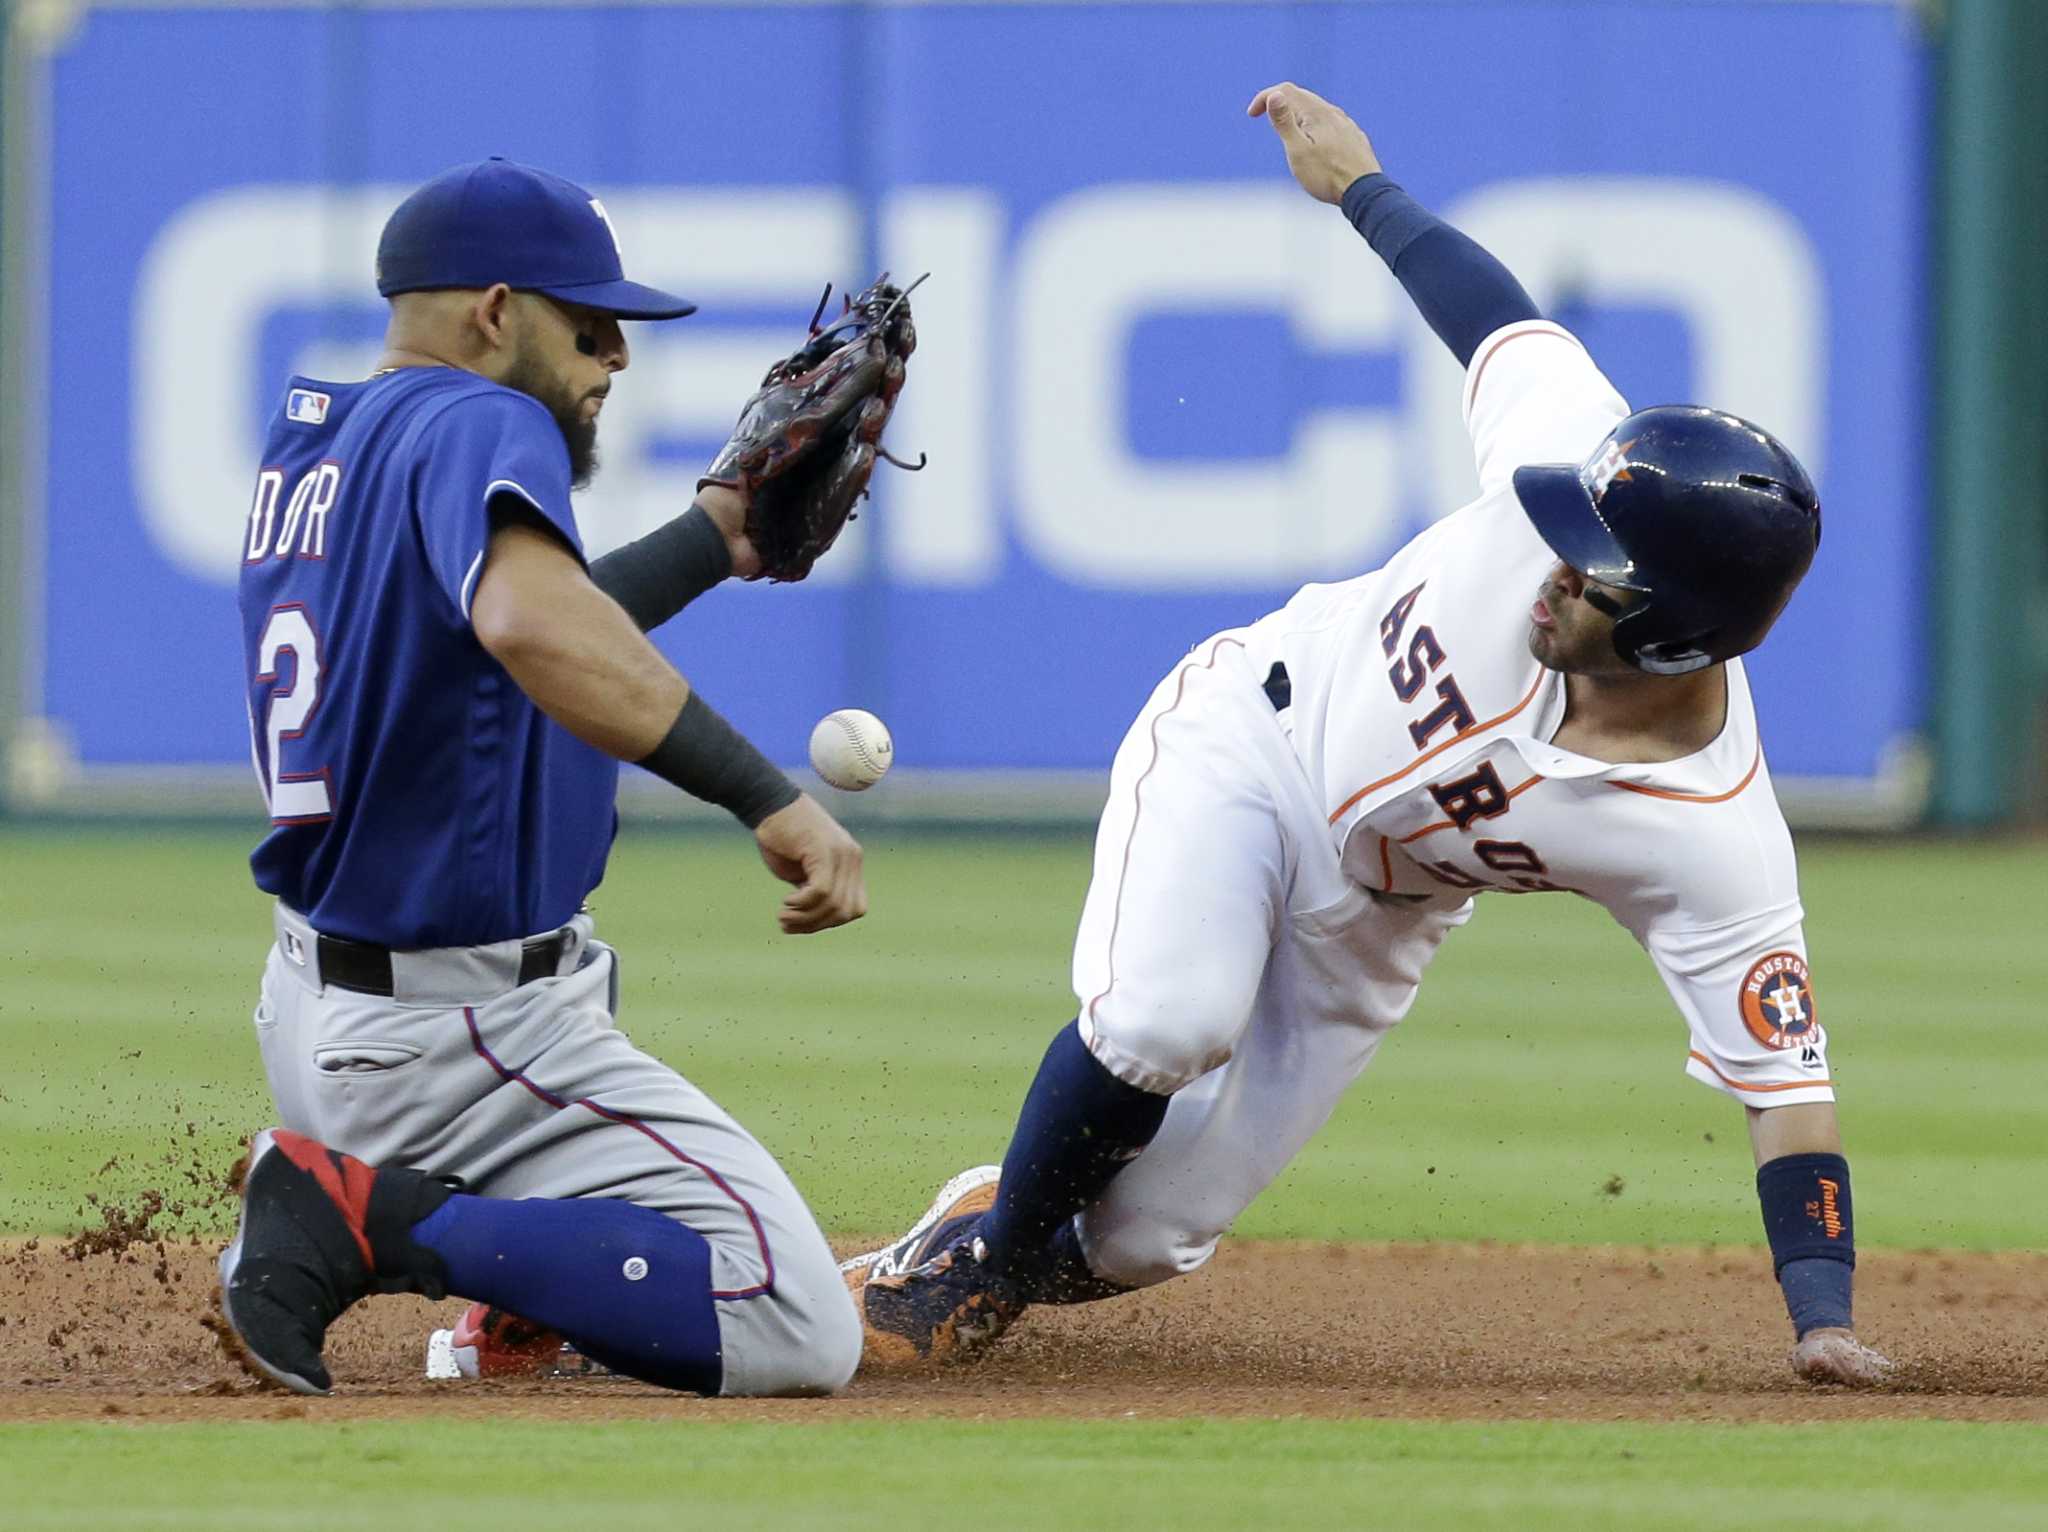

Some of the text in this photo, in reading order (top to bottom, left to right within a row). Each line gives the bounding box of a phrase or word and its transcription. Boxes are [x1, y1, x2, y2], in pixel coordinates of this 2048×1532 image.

[130, 180, 1828, 590] GEICO
[247, 602, 337, 826] 2
[1747, 957, 1809, 994] HOUSTON
[1769, 985, 1806, 1025] H
